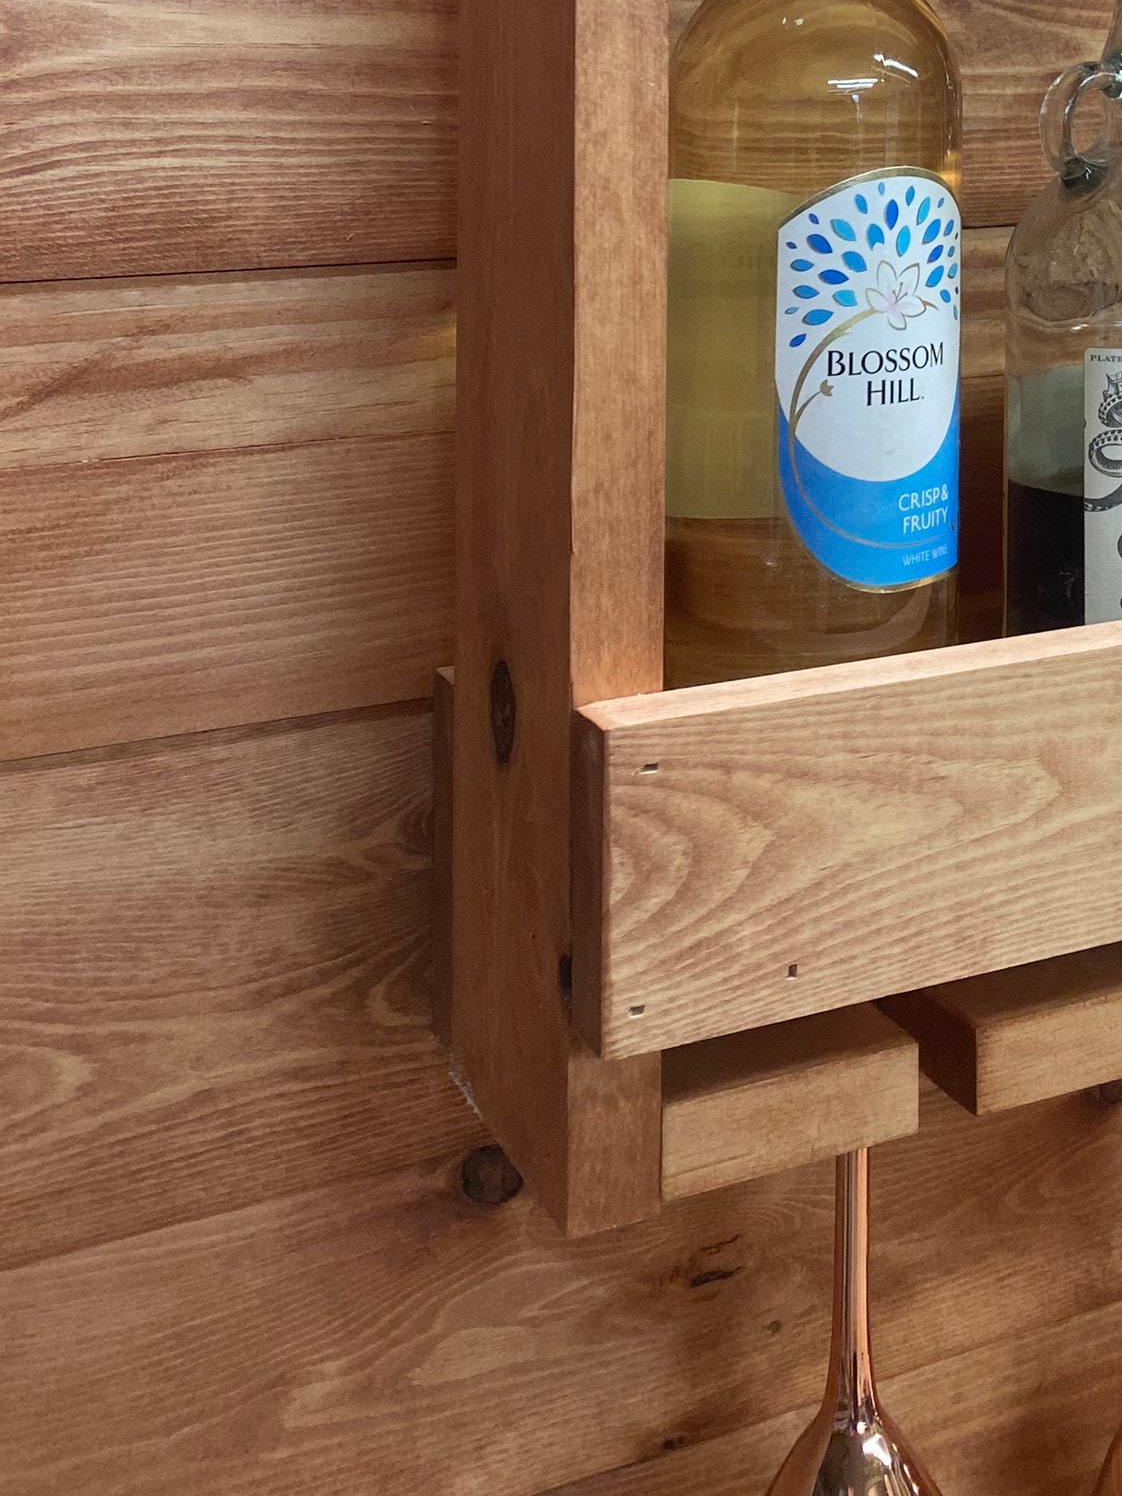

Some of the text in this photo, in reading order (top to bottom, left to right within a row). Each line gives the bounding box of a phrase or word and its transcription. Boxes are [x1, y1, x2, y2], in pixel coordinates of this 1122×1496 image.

[826, 341, 944, 377] BLOSSOM
[866, 377, 921, 407] HILL
[902, 505, 950, 535] FRUITY
[902, 549, 931, 567] WHITE
